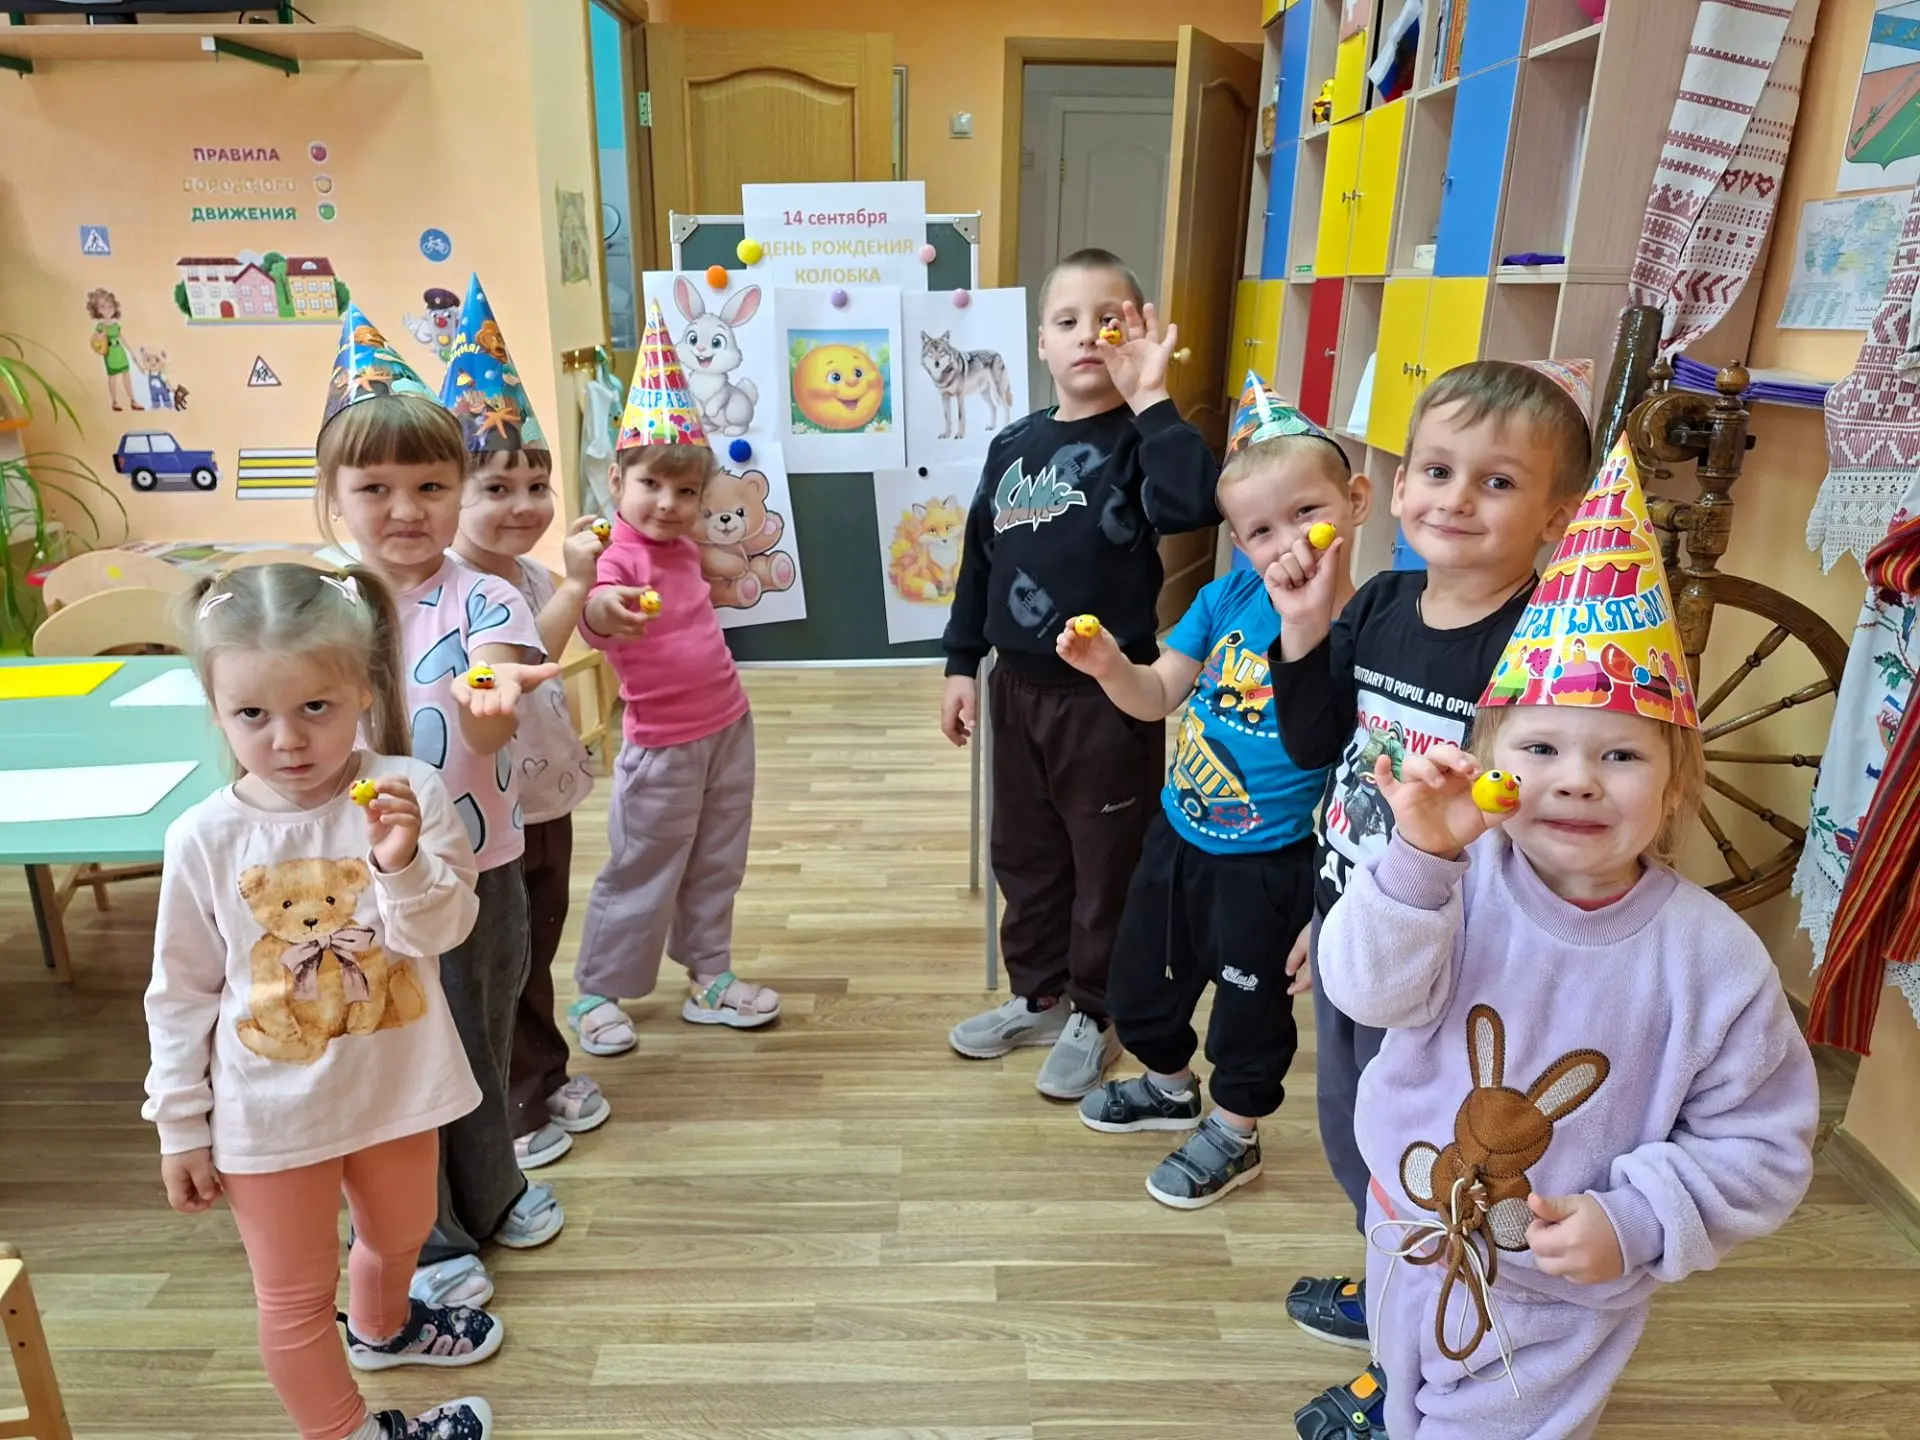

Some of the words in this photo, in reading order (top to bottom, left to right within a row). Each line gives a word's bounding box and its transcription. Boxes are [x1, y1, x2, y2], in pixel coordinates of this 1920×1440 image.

[193, 147, 281, 162] ПРАВИЛА
[182, 177, 297, 193] ДОРОЖНОГО
[192, 207, 297, 222] ДВИЖЕНИЯ
[783, 210, 804, 226] 14
[808, 208, 888, 228] сентября
[761, 240, 806, 260] ДЕНЬ
[812, 238, 914, 258] РОЖДЕНИЯ
[795, 267, 881, 285] КОЛОБКА
[1384, 676, 1395, 693] TO
